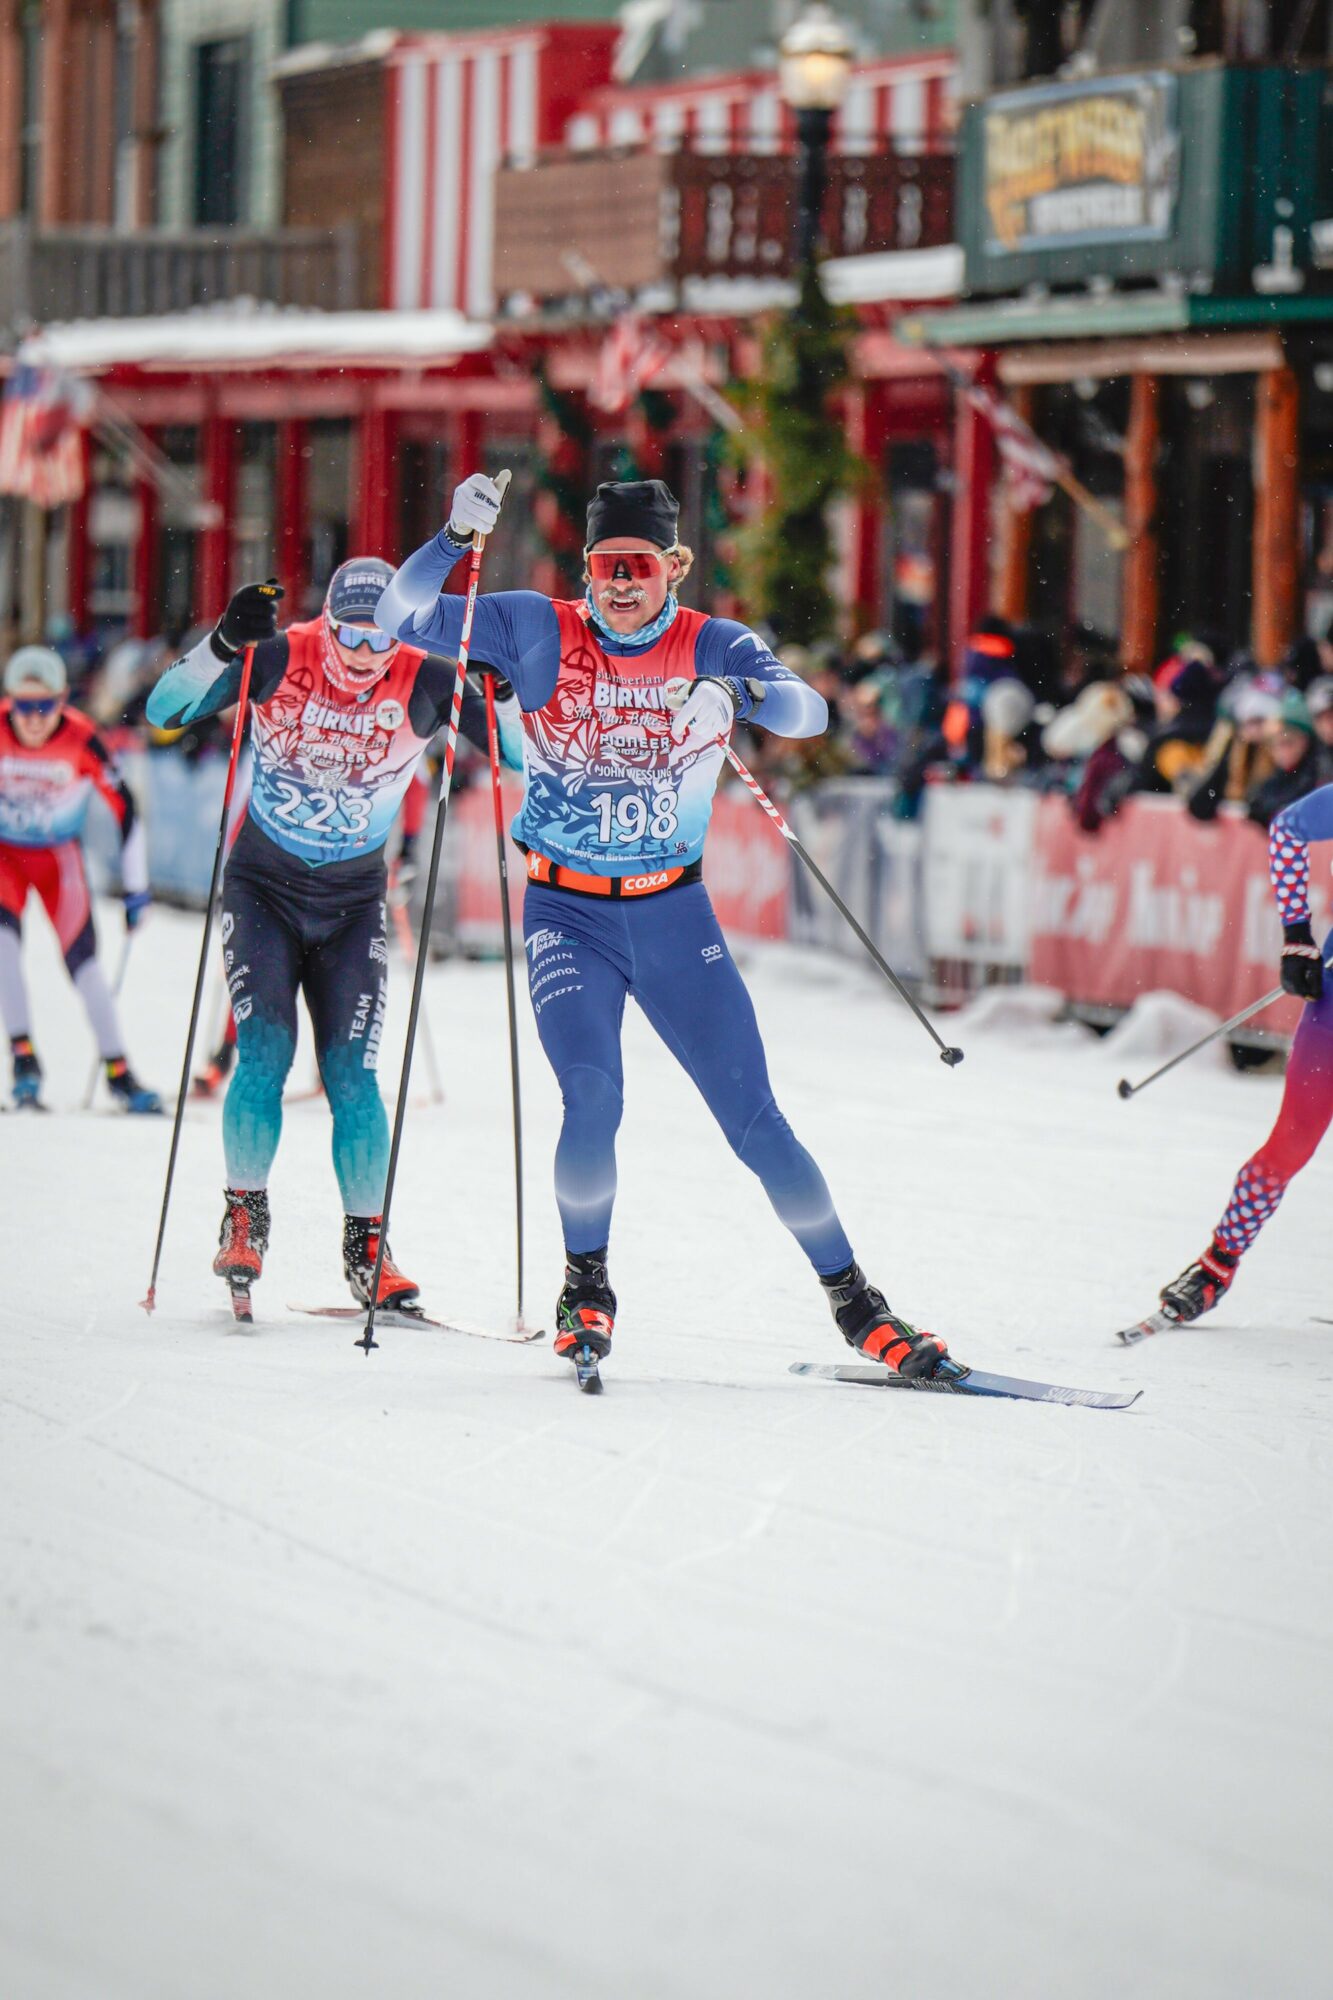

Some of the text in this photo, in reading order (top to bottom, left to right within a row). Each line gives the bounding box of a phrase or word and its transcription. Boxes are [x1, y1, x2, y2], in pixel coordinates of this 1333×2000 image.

[596, 668, 664, 685] slumberlan
[300, 700, 376, 736] BIRKIE
[599, 734, 671, 750] PIONEER
[598, 764, 672, 781] JOHN WESSLING
[274, 781, 373, 835] 223
[589, 790, 679, 843] 198
[624, 873, 669, 890] COXA
[540, 985, 584, 1005] SCOTT
[349, 994, 373, 1040] TEAM
